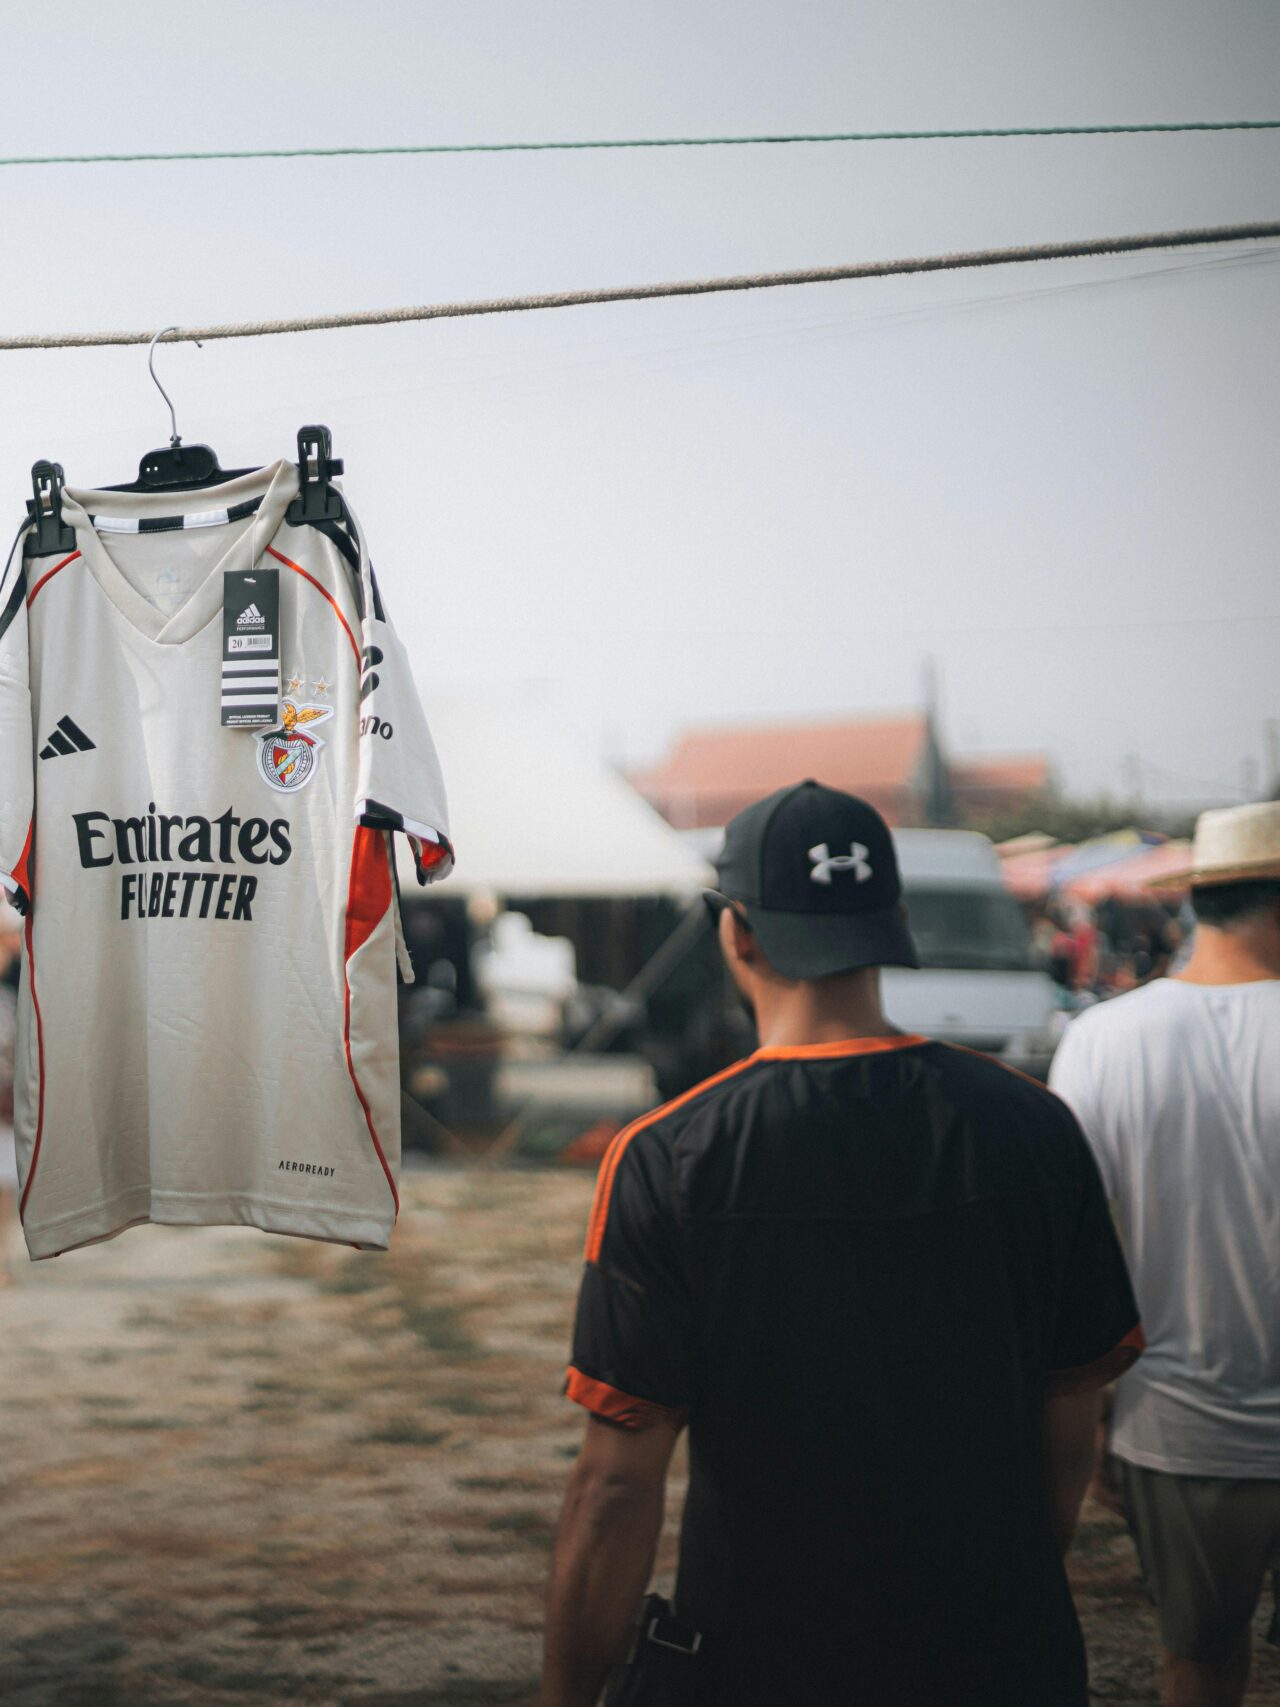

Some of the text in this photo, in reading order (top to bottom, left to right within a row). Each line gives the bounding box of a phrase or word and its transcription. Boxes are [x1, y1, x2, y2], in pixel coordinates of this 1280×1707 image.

[237, 616, 266, 624] adidas
[232, 639, 243, 648] 20
[72, 801, 292, 869] Emirates
[148, 871, 258, 922] BETTER
[279, 1160, 335, 1177] AEROREADY
